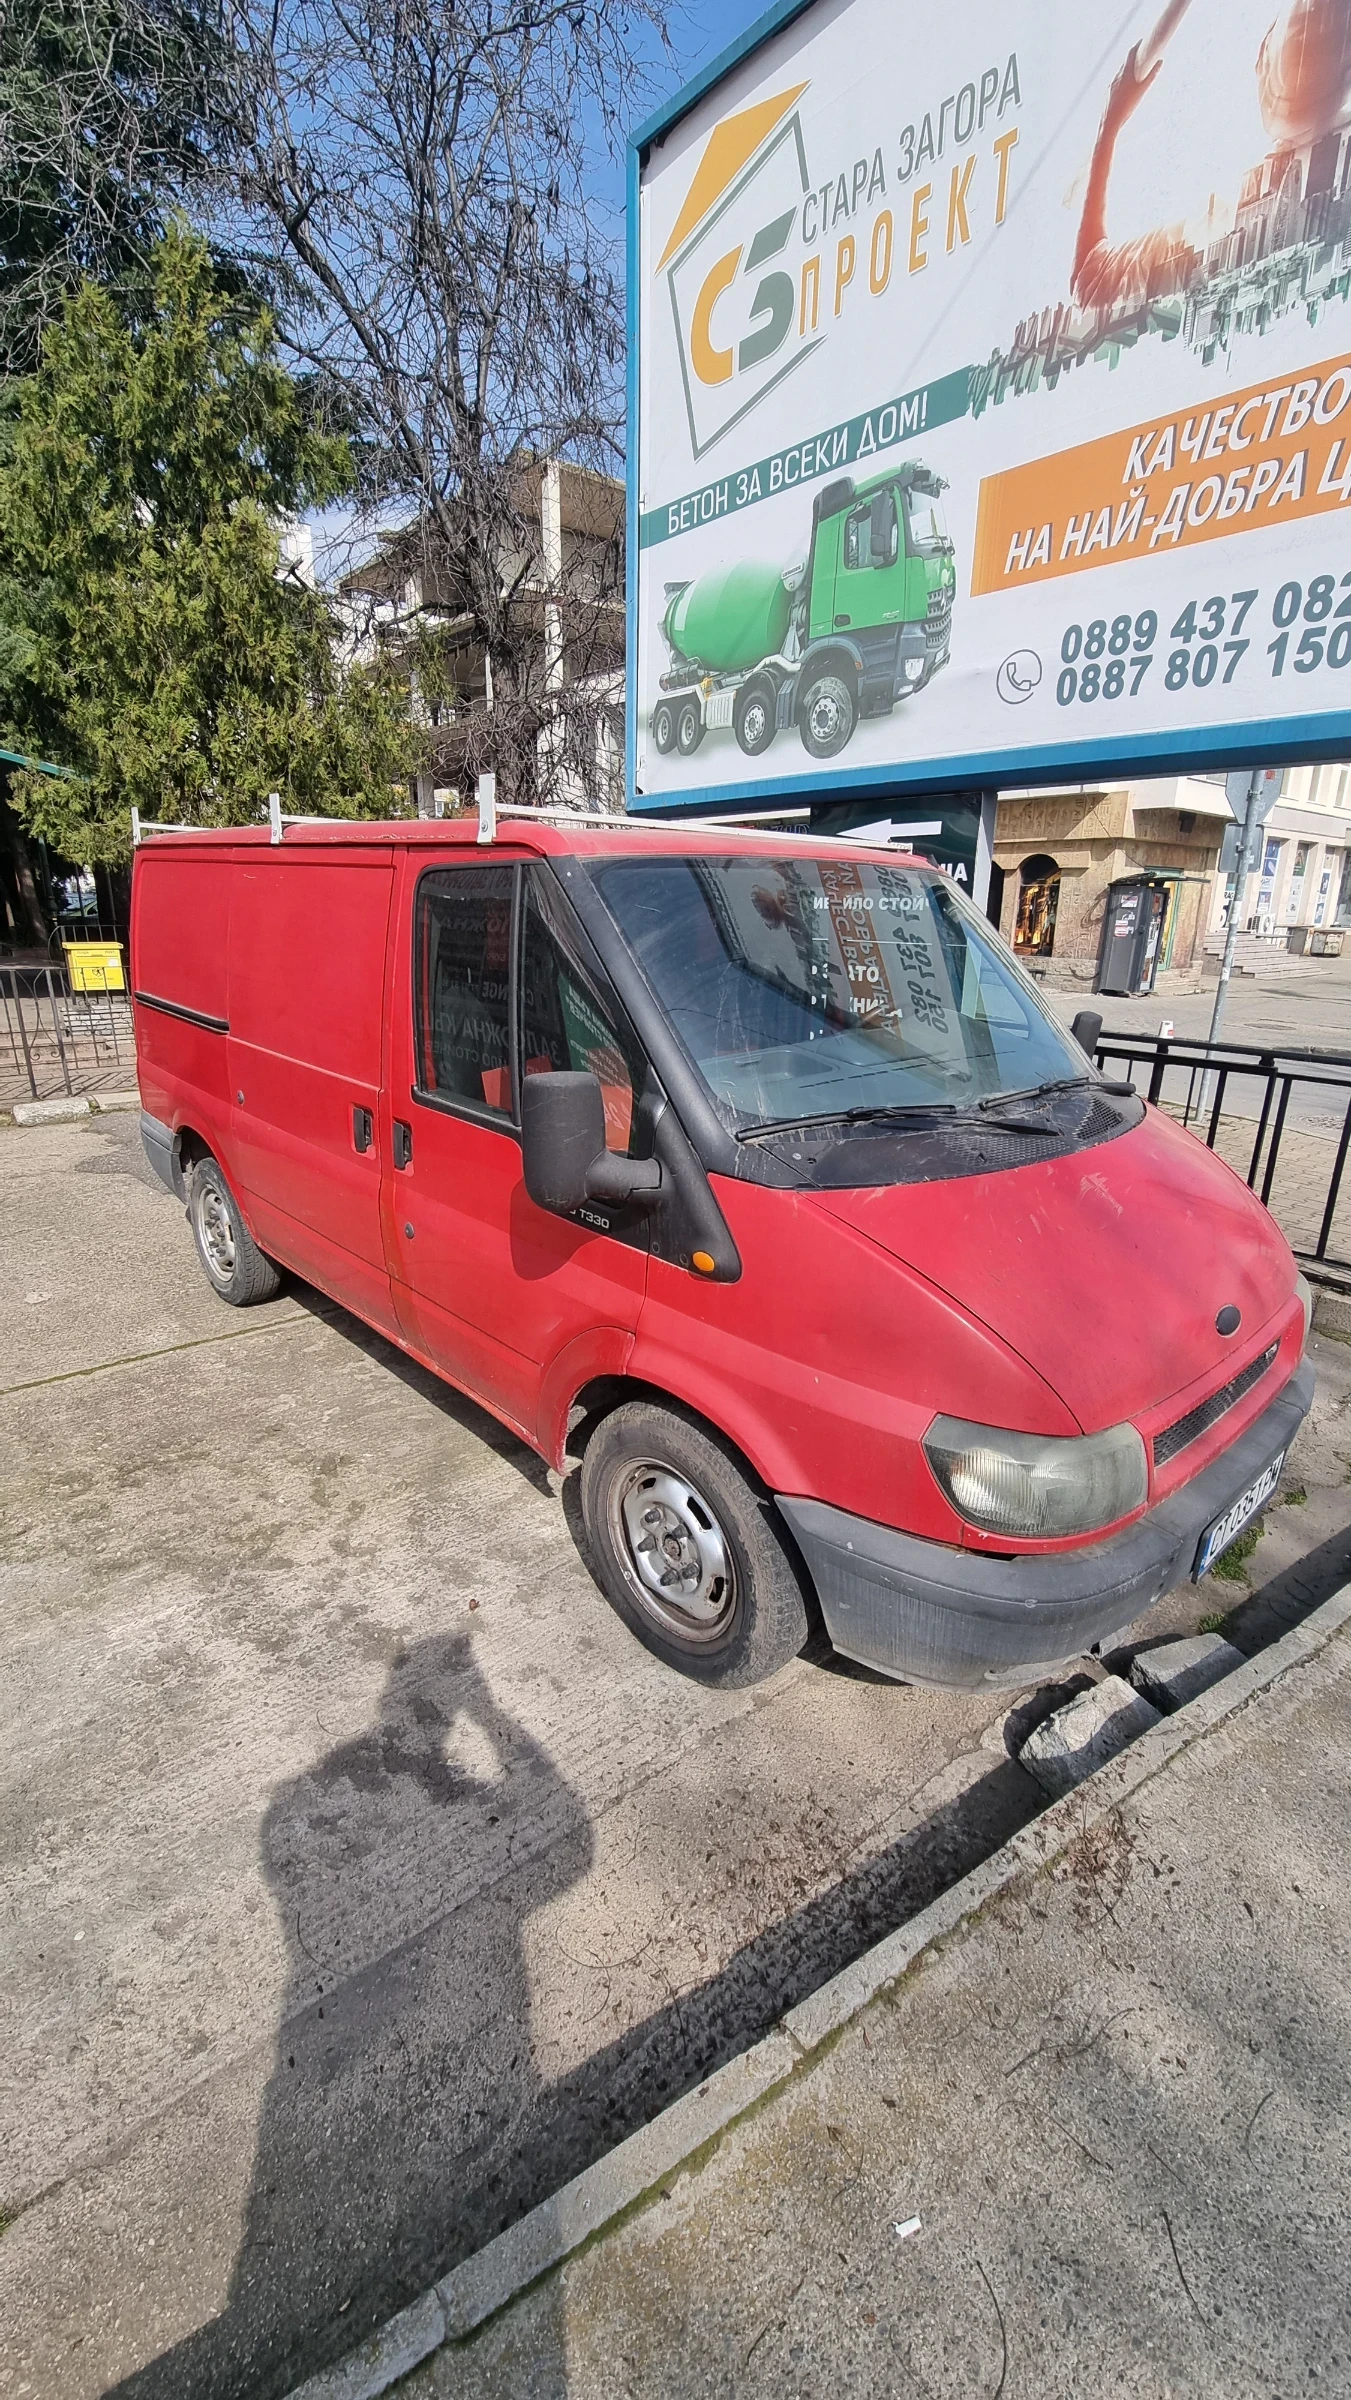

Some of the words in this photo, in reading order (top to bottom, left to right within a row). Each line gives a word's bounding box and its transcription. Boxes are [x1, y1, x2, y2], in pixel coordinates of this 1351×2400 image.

[802, 147, 886, 241] СТАРА
[897, 52, 1021, 181] ЗАГОРА
[799, 127, 1019, 337] ПРОЕКТ
[668, 484, 729, 535] БЕТОН
[735, 468, 762, 504] ЗА
[769, 426, 849, 491] ВСЕКИ
[856, 390, 928, 460] ДОМ!
[1121, 366, 1351, 485] КАЧЕСТВО
[1003, 523, 1053, 575] НА
[1059, 448, 1309, 561] НАЙ-ДОБРА
[1056, 654, 1153, 706] 0887
[1164, 638, 1250, 692] 807
[1266, 621, 1351, 678] 150
[1060, 609, 1158, 664] 0889
[1170, 588, 1259, 644] 437
[878, 895, 929, 910] СТОЙ
[579, 1208, 610, 1229] T330
